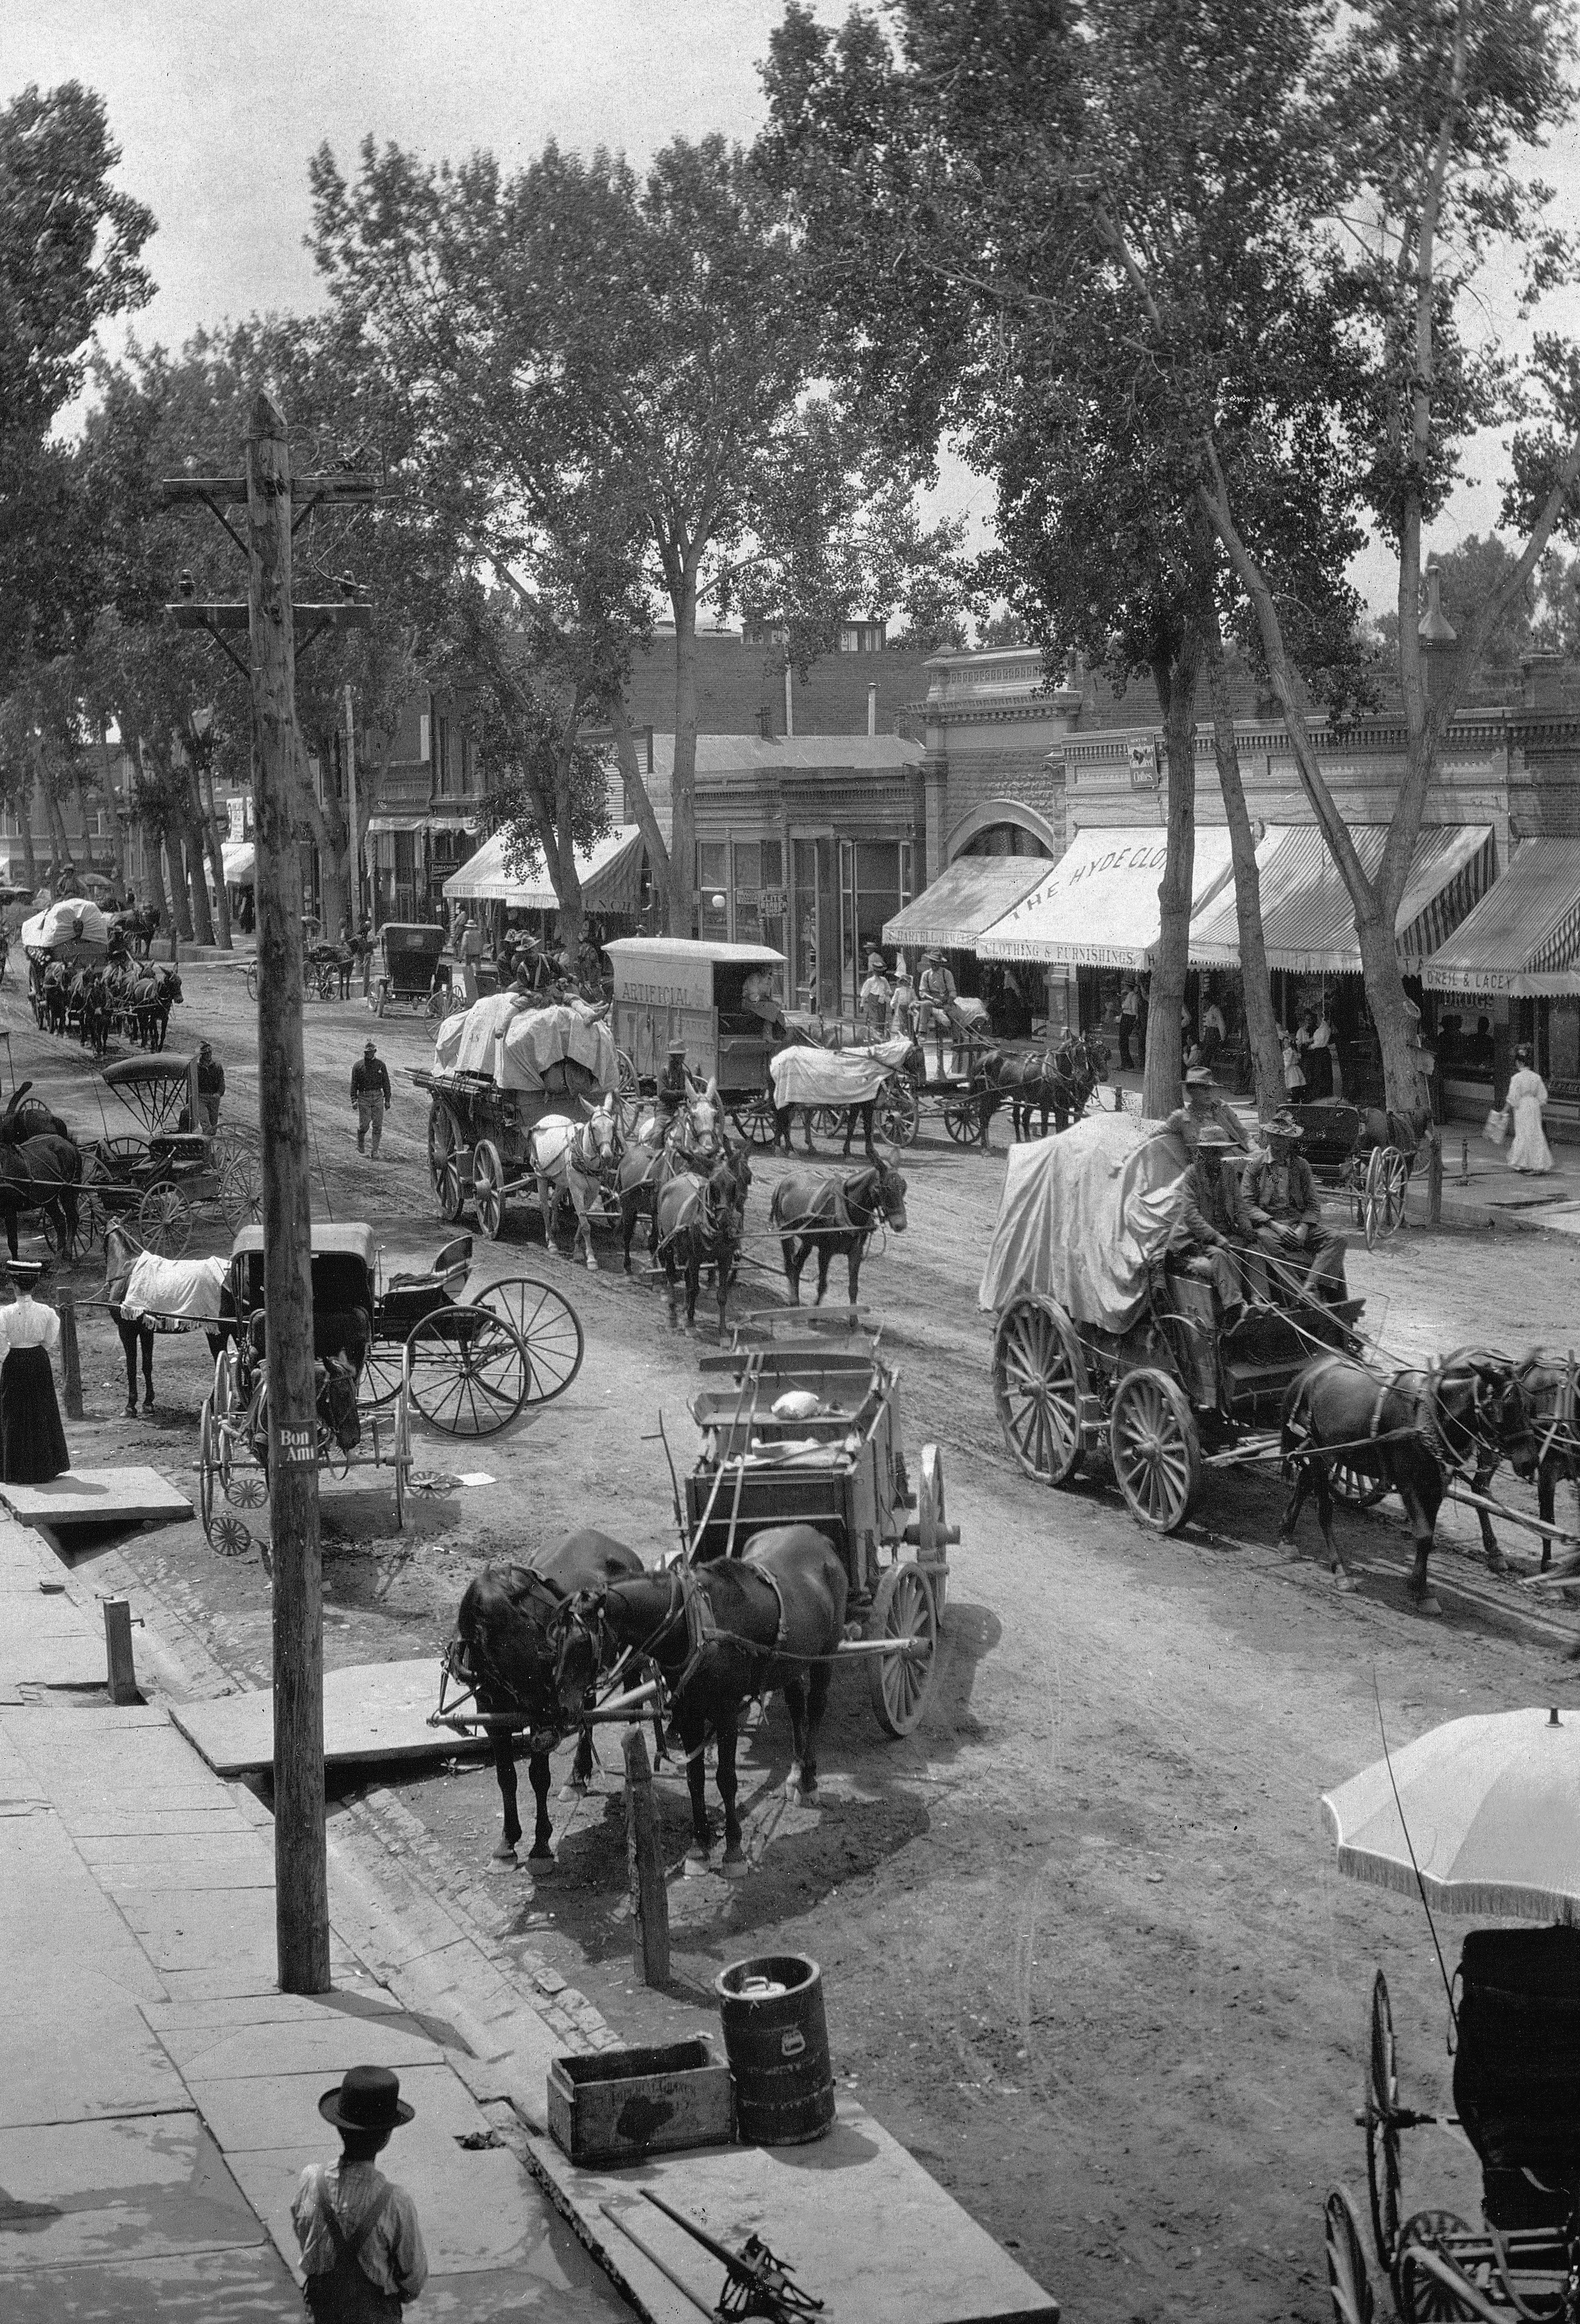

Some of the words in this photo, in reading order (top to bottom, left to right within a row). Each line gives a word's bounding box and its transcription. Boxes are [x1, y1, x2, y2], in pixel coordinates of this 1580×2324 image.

[1010, 882, 1059, 920] THE
[1069, 847, 1131, 886] HYDE
[585, 900, 631, 911] UNCH
[985, 943, 1038, 956] CLOTHING
[1044, 948, 1051, 958] &
[1463, 973, 1469, 987] &
[1476, 974, 1511, 988] LACEY
[622, 982, 691, 1006] ARTIFICIAL
[280, 1430, 309, 1446] Bon
[287, 1446, 315, 1462] Ami
